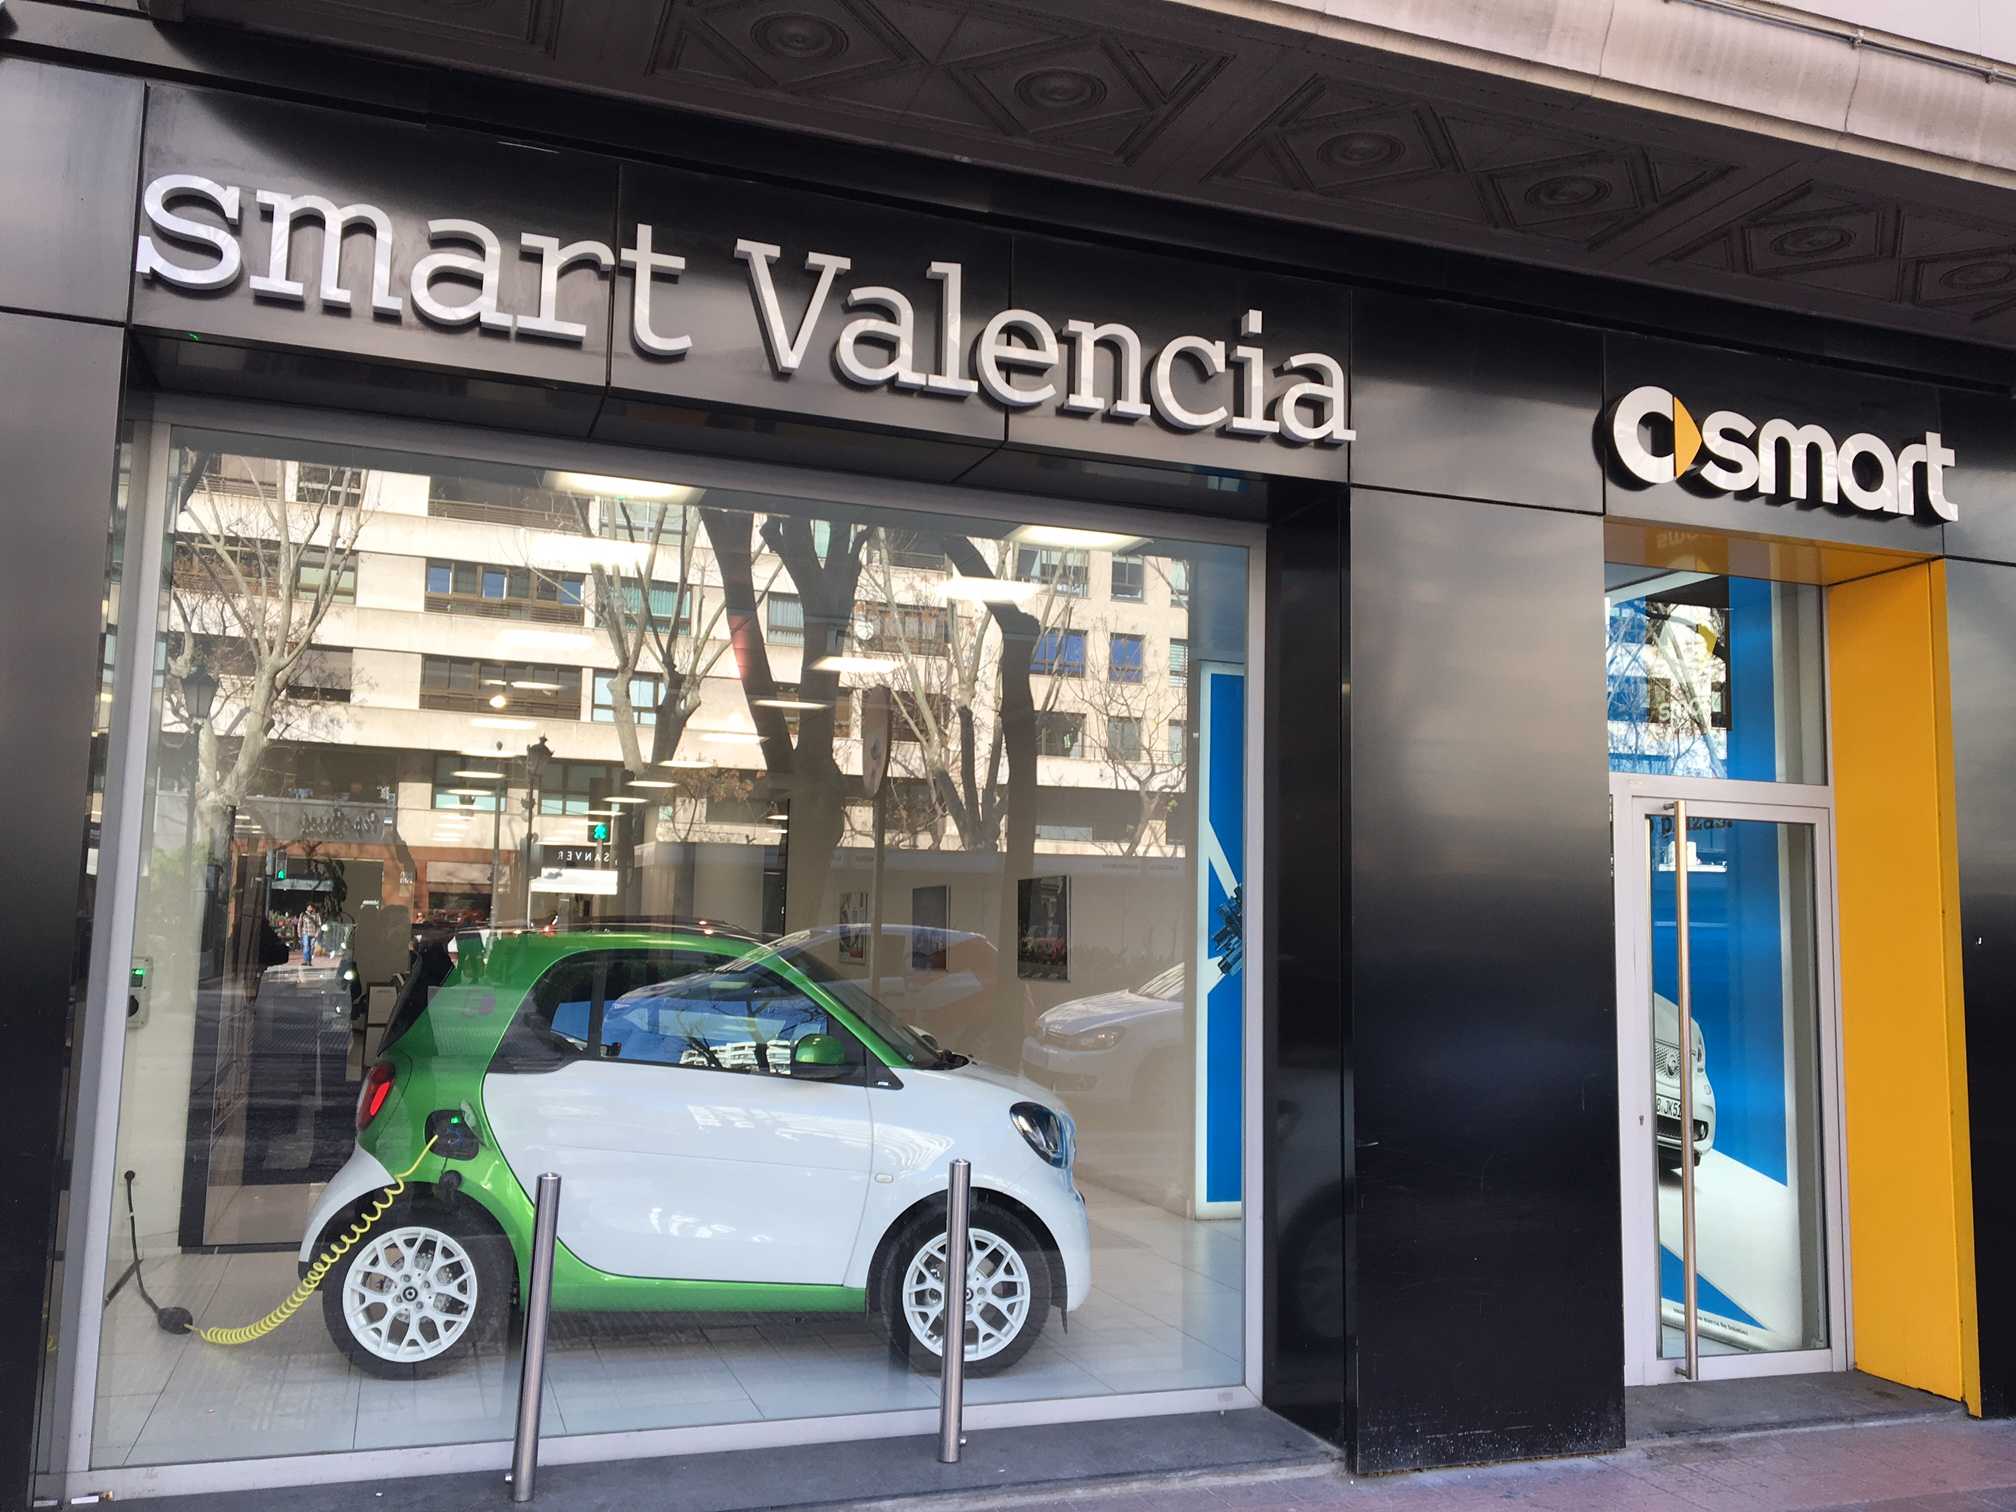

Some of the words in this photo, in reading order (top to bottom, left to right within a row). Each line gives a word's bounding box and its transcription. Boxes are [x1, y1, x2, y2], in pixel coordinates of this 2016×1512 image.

[135, 173, 693, 357] smart
[733, 238, 1357, 443] Valencia
[1700, 410, 1960, 523] smart
